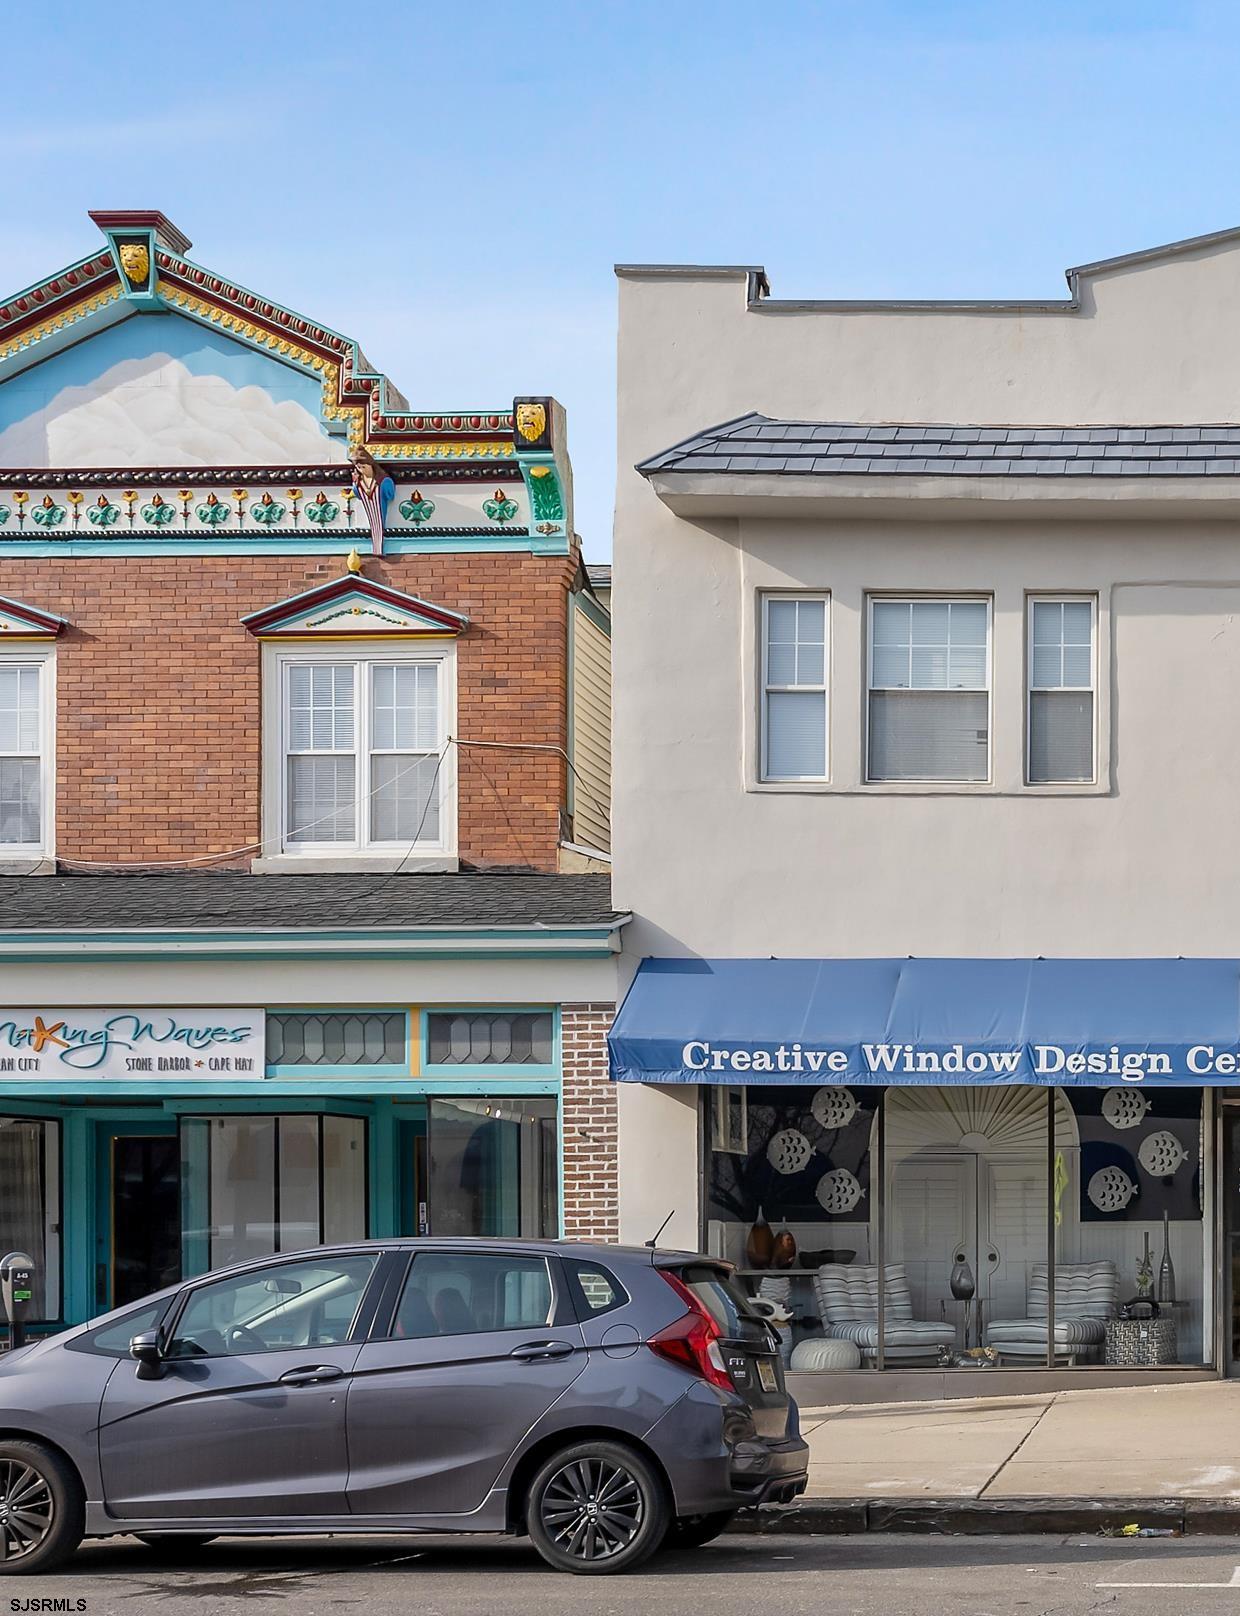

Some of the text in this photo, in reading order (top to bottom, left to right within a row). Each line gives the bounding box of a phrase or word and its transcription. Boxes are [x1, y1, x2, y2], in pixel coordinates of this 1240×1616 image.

[105, 1015, 251, 1049] Waves
[0, 1057, 39, 1071] AN CITY
[125, 1057, 253, 1071] STONE HARBOR CAPE MAY
[682, 1041, 848, 1073] Creative
[862, 1044, 1022, 1073] Window
[1034, 1045, 1173, 1081] Design
[729, 1357, 746, 1366] FIT
